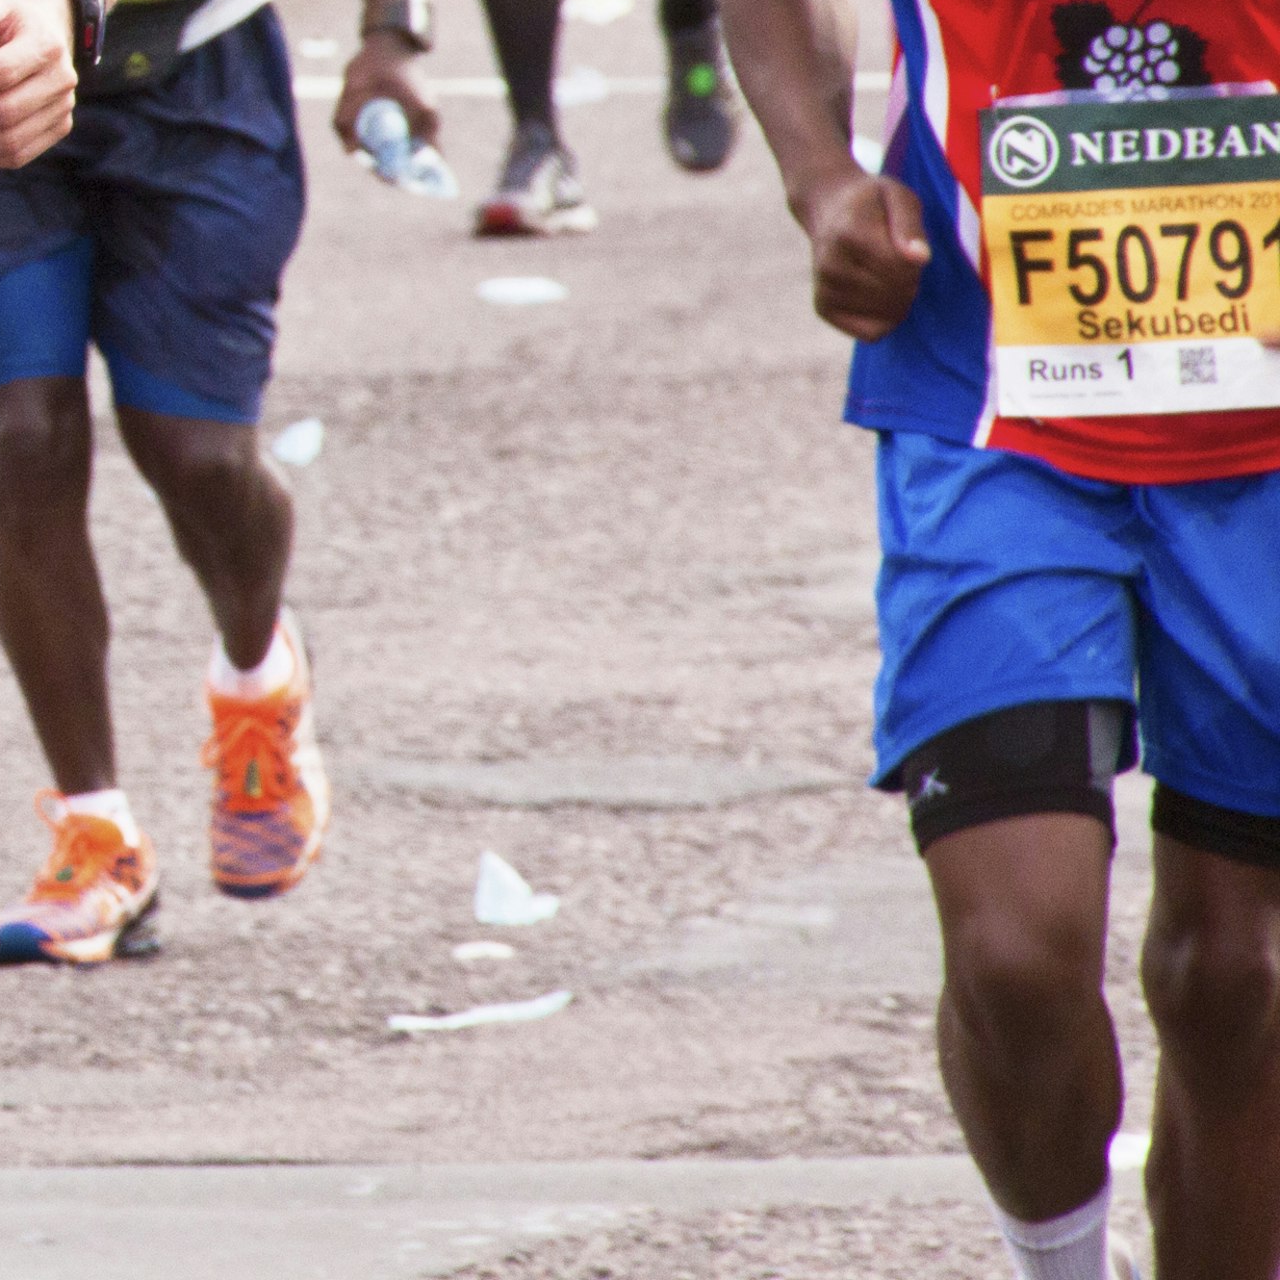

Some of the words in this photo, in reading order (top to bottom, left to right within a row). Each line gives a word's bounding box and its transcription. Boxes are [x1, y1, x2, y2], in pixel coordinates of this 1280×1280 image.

[1069, 121, 1280, 166] NEDBAN
[1010, 198, 1126, 221] COMRADES
[1131, 192, 1244, 214] MARATHON
[1250, 190, 1280, 210] 20
[1077, 303, 1251, 341] Sekubedi
[1028, 358, 1103, 382] Runs
[1117, 347, 1135, 381] 1
